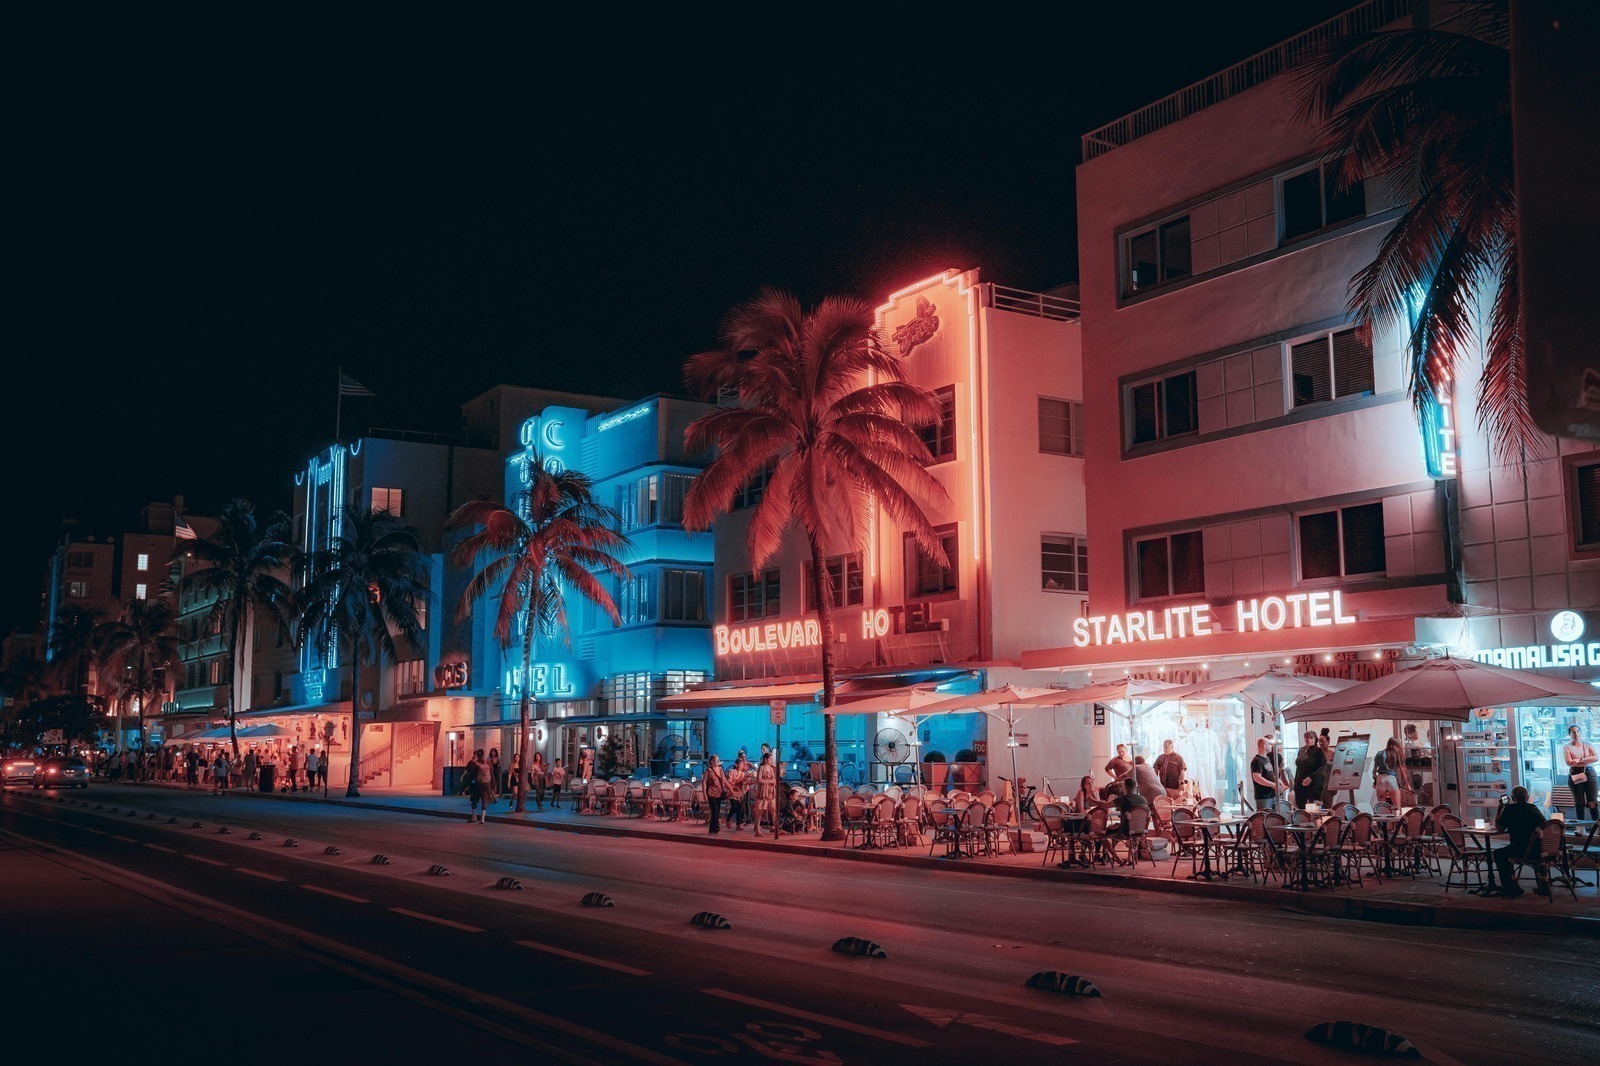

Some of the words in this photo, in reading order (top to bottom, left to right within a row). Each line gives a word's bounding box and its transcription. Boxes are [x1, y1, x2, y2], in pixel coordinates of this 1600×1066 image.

[715, 619, 823, 656] BOULEVAR
[862, 601, 943, 640] HOTEL
[1073, 603, 1212, 648] STARLITE
[1237, 590, 1356, 633] HOTEL
[1473, 643, 1586, 670] MAMALISA
